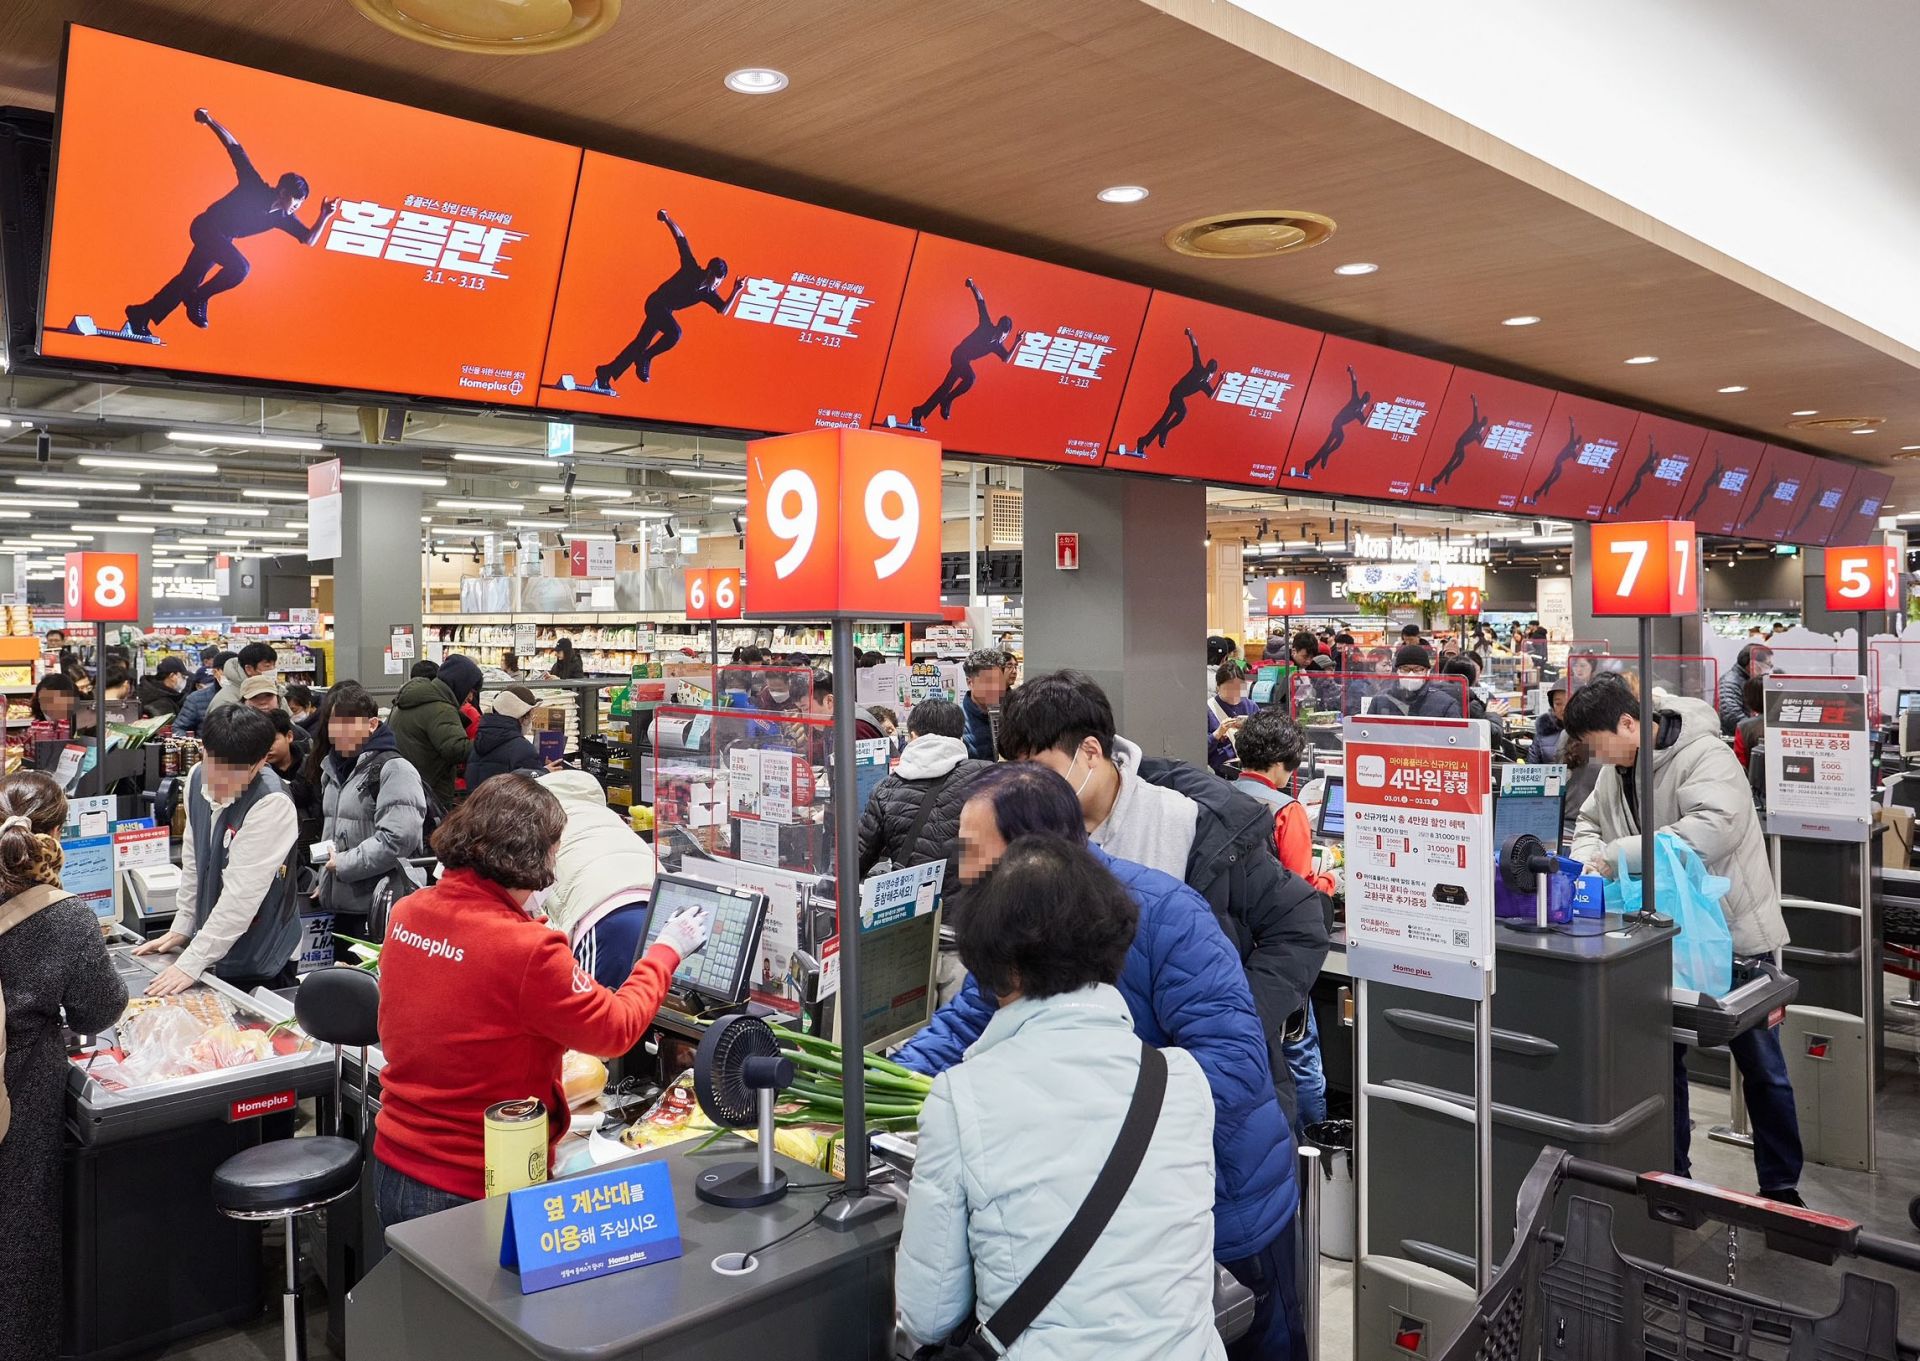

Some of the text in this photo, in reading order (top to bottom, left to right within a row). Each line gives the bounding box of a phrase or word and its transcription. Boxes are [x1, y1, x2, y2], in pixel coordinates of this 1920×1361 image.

[404, 194, 512, 224] 홈플러스 창립 단독 슈퍼세일
[325, 200, 529, 279] 홈플런
[423, 270, 445, 284] 3.1.
[458, 276, 486, 290] 3.13.
[791, 271, 815, 283] 홈플러스
[734, 277, 875, 338] 홈플런
[1014, 332, 1117, 379] 홈플런
[459, 378, 507, 391] Homeplus
[1216, 372, 1295, 412] 홈플런
[815, 418, 848, 429] Homeplus
[1065, 448, 1090, 457] Homeplus
[766, 469, 818, 580] 9
[864, 470, 919, 580] 9
[1610, 540, 1648, 597] 7
[1675, 540, 1689, 596] 7
[1838, 558, 1871, 598] 5
[1886, 558, 1896, 598] 5
[68, 566, 79, 608] 8
[94, 565, 126, 607] 8
[690, 578, 704, 610] 6
[716, 576, 735, 606] 6
[1272, 588, 1286, 608] 4
[1293, 588, 1302, 608] 4
[1452, 591, 1465, 610] 2
[1470, 592, 1478, 610] 2
[1782, 738, 1850, 751] 할인쿠폰 증정
[1389, 757, 1468, 770] 마이홈플러스 신규가입 시
[1389, 768, 1441, 792] 4만원
[1443, 780, 1468, 795] 증정
[1363, 812, 1388, 822] 신규가입
[1389, 815, 1396, 823] 시
[1407, 816, 1429, 826] 4만원
[1431, 817, 1447, 828] 할인
[1449, 820, 1466, 830] 혜택
[1364, 891, 1427, 907] 교환쿠폰 추가증정
[1361, 924, 1378, 932] Quick
[390, 921, 465, 962] Homeplus
[1393, 964, 1431, 977] Home plus
[237, 1094, 289, 1114] Homeplus
[543, 1181, 645, 1222] 옆 계산대를
[540, 1213, 658, 1254] 이용해 주십시오
[608, 1251, 645, 1266] Home plus
